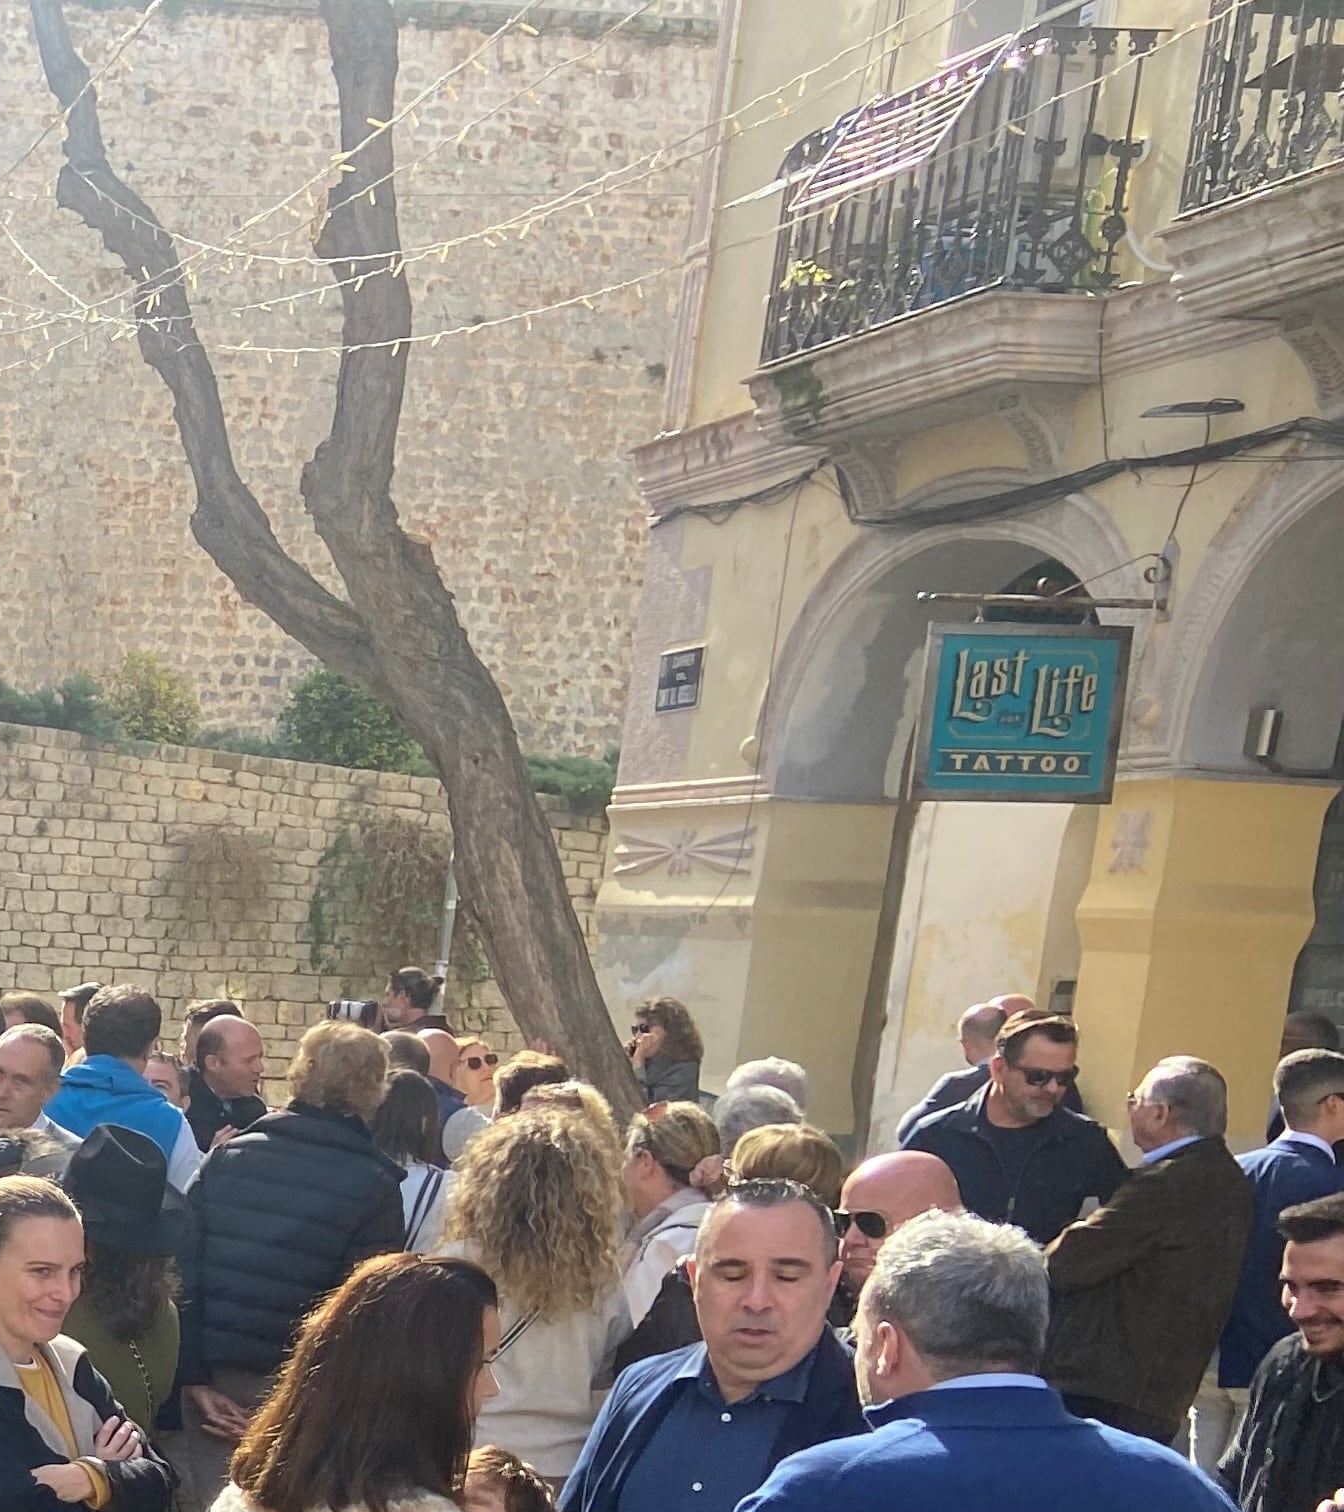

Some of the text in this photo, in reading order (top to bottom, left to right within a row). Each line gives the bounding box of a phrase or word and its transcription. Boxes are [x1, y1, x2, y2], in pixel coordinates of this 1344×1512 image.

[950, 648, 1098, 738] Last Life
[949, 753, 1081, 772] TATTOO
